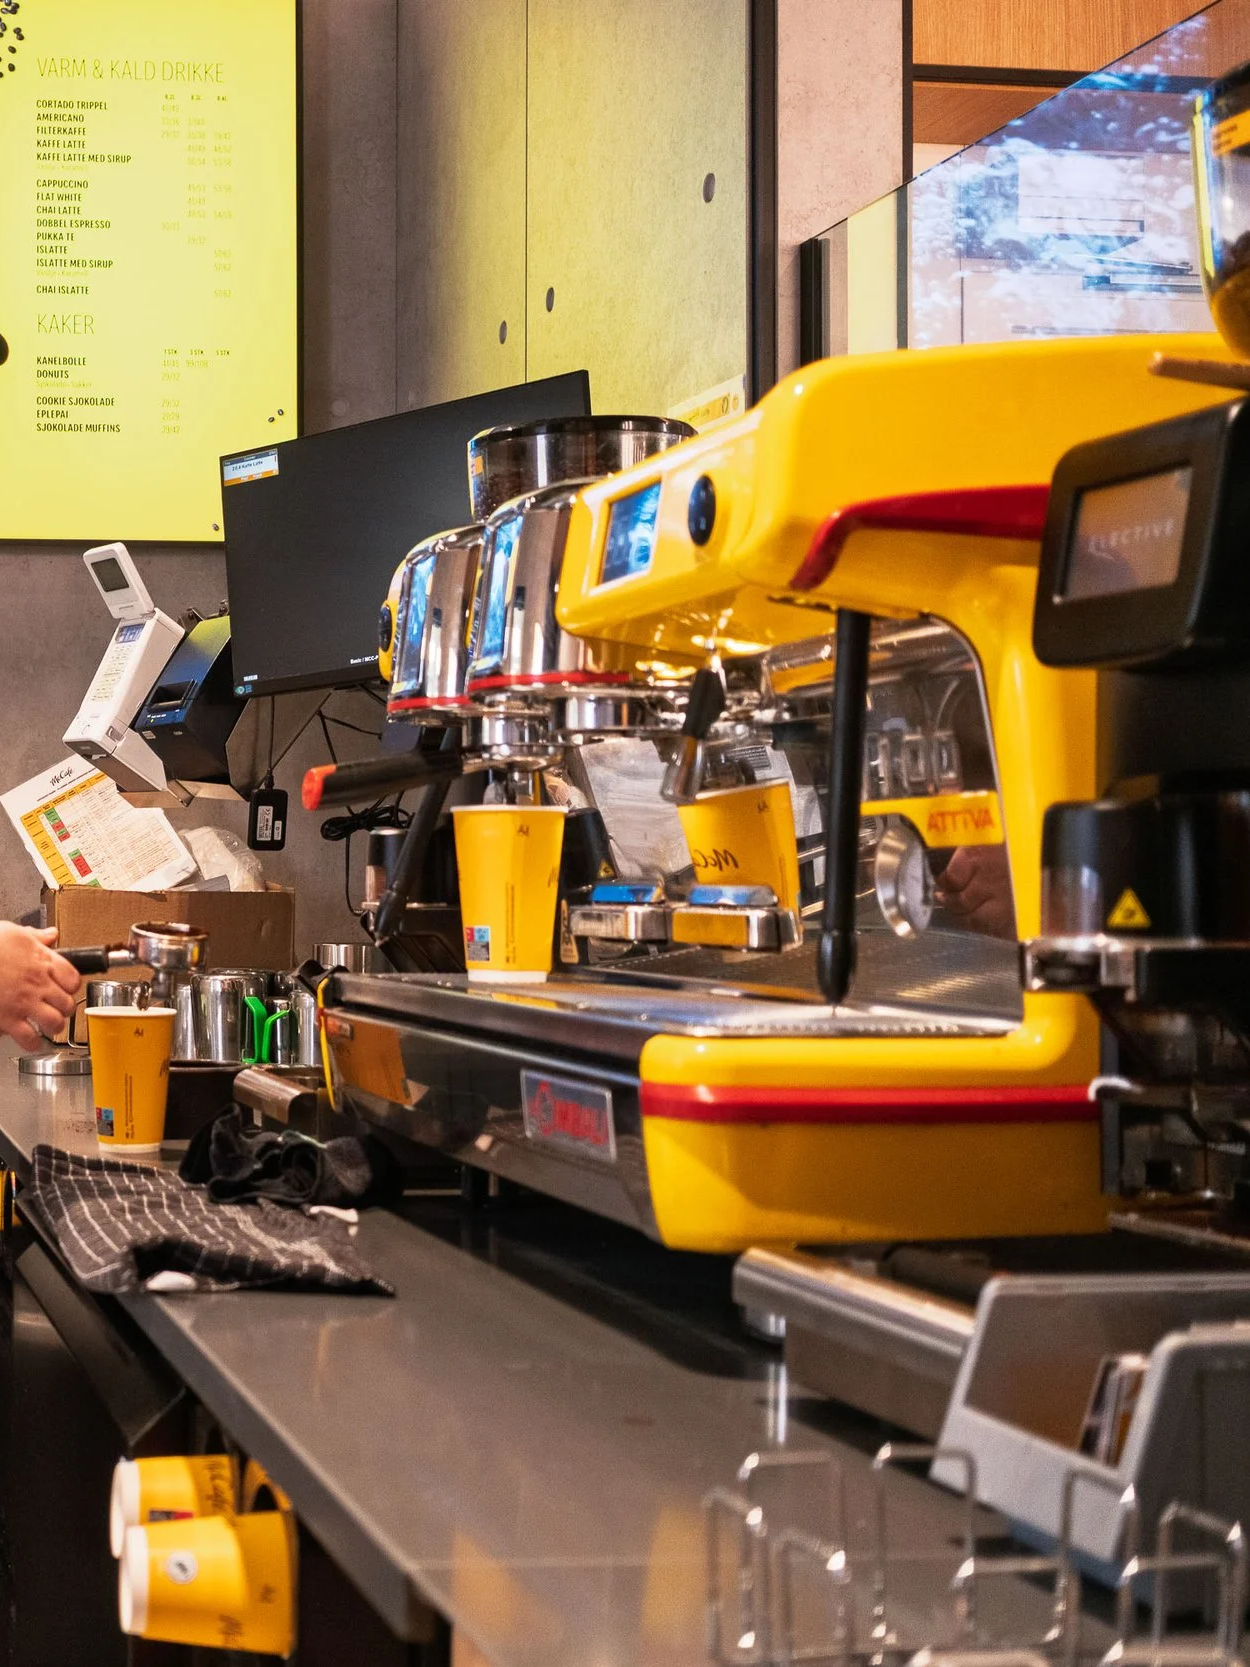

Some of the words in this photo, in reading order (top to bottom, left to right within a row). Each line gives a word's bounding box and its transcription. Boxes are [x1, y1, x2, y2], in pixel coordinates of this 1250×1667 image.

[37, 57, 87, 79] VARM
[92, 59, 104, 79] &
[110, 60, 156, 81] KALD
[162, 61, 225, 83] DRIKKE
[36, 100, 74, 109] CORTADO
[77, 101, 108, 110] TRIPPEL
[36, 113, 85, 123] AMERICANO
[36, 126, 86, 136] FILTERKAFFE
[36, 139, 60, 149] KAFFE
[63, 140, 86, 149] LATTE
[36, 152, 60, 162] KAFFE
[63, 153, 86, 162] LATTE
[88, 154, 105, 163] MED
[107, 154, 132, 164] SIRUP
[36, 179, 89, 189] CAPPUCCINO
[36, 193, 55, 202] FLAT
[57, 193, 82, 202] WHITE
[36, 206, 56, 215] CHAI
[58, 206, 81, 215] LATTE
[36, 219, 67, 228] DOBBEL
[70, 220, 111, 229] ESPRESSO
[36, 232, 64, 241] PUKKA
[67, 232, 74, 241] TE
[36, 245, 68, 254] ISLATTE
[36, 258, 68, 268] ISLATTE
[69, 259, 87, 268] MED
[89, 259, 113, 269] SIRUP
[36, 285, 56, 294] CHAI
[58, 285, 89, 295] ISLATTE
[37, 314, 94, 335] KAKER
[36, 356, 87, 366] KANELBOLLE
[36, 370, 69, 379] DONUTS
[36, 397, 67, 406] COOKIE
[69, 397, 115, 407] SJOKOLADE
[36, 410, 69, 419] EPLEPAI
[36, 423, 83, 433] SJOKOLADE
[85, 424, 120, 433] MUFFINS
